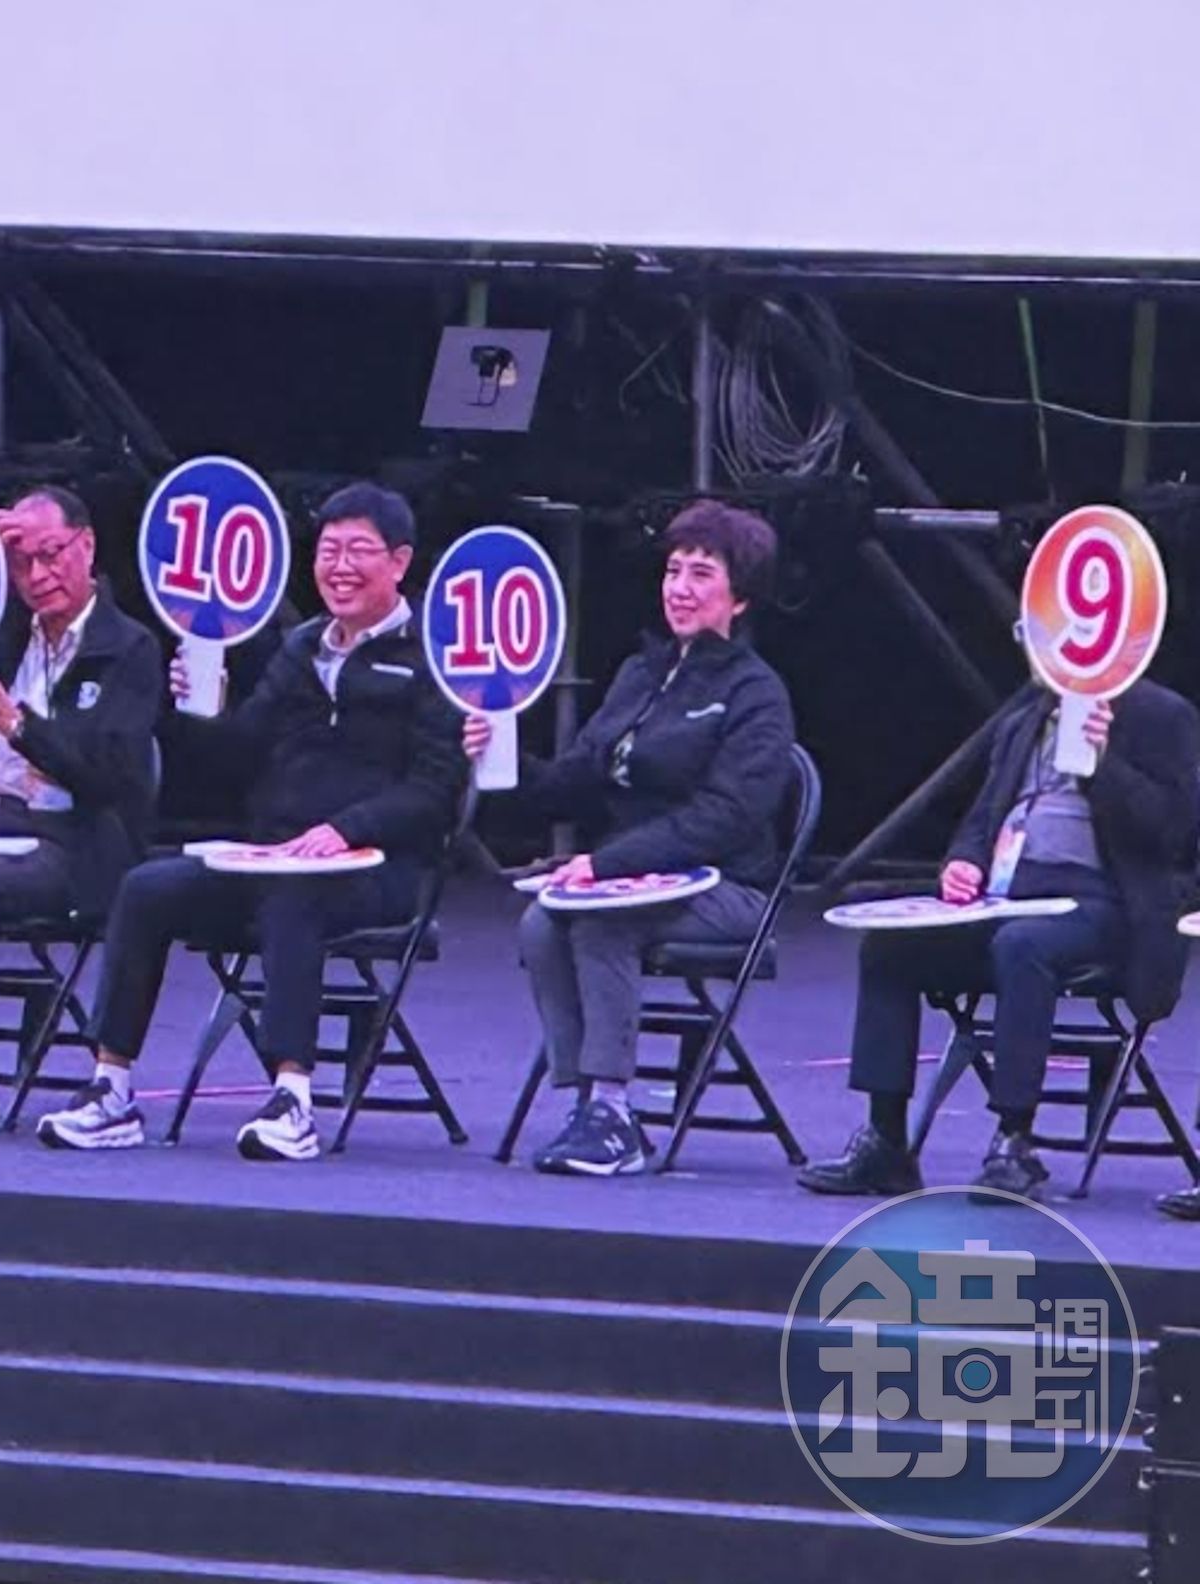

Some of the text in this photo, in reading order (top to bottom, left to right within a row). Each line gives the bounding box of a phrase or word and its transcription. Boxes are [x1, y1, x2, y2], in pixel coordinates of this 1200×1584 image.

[158, 494, 273, 611] 10
[1056, 531, 1131, 675] 9
[443, 566, 548, 676] 10
